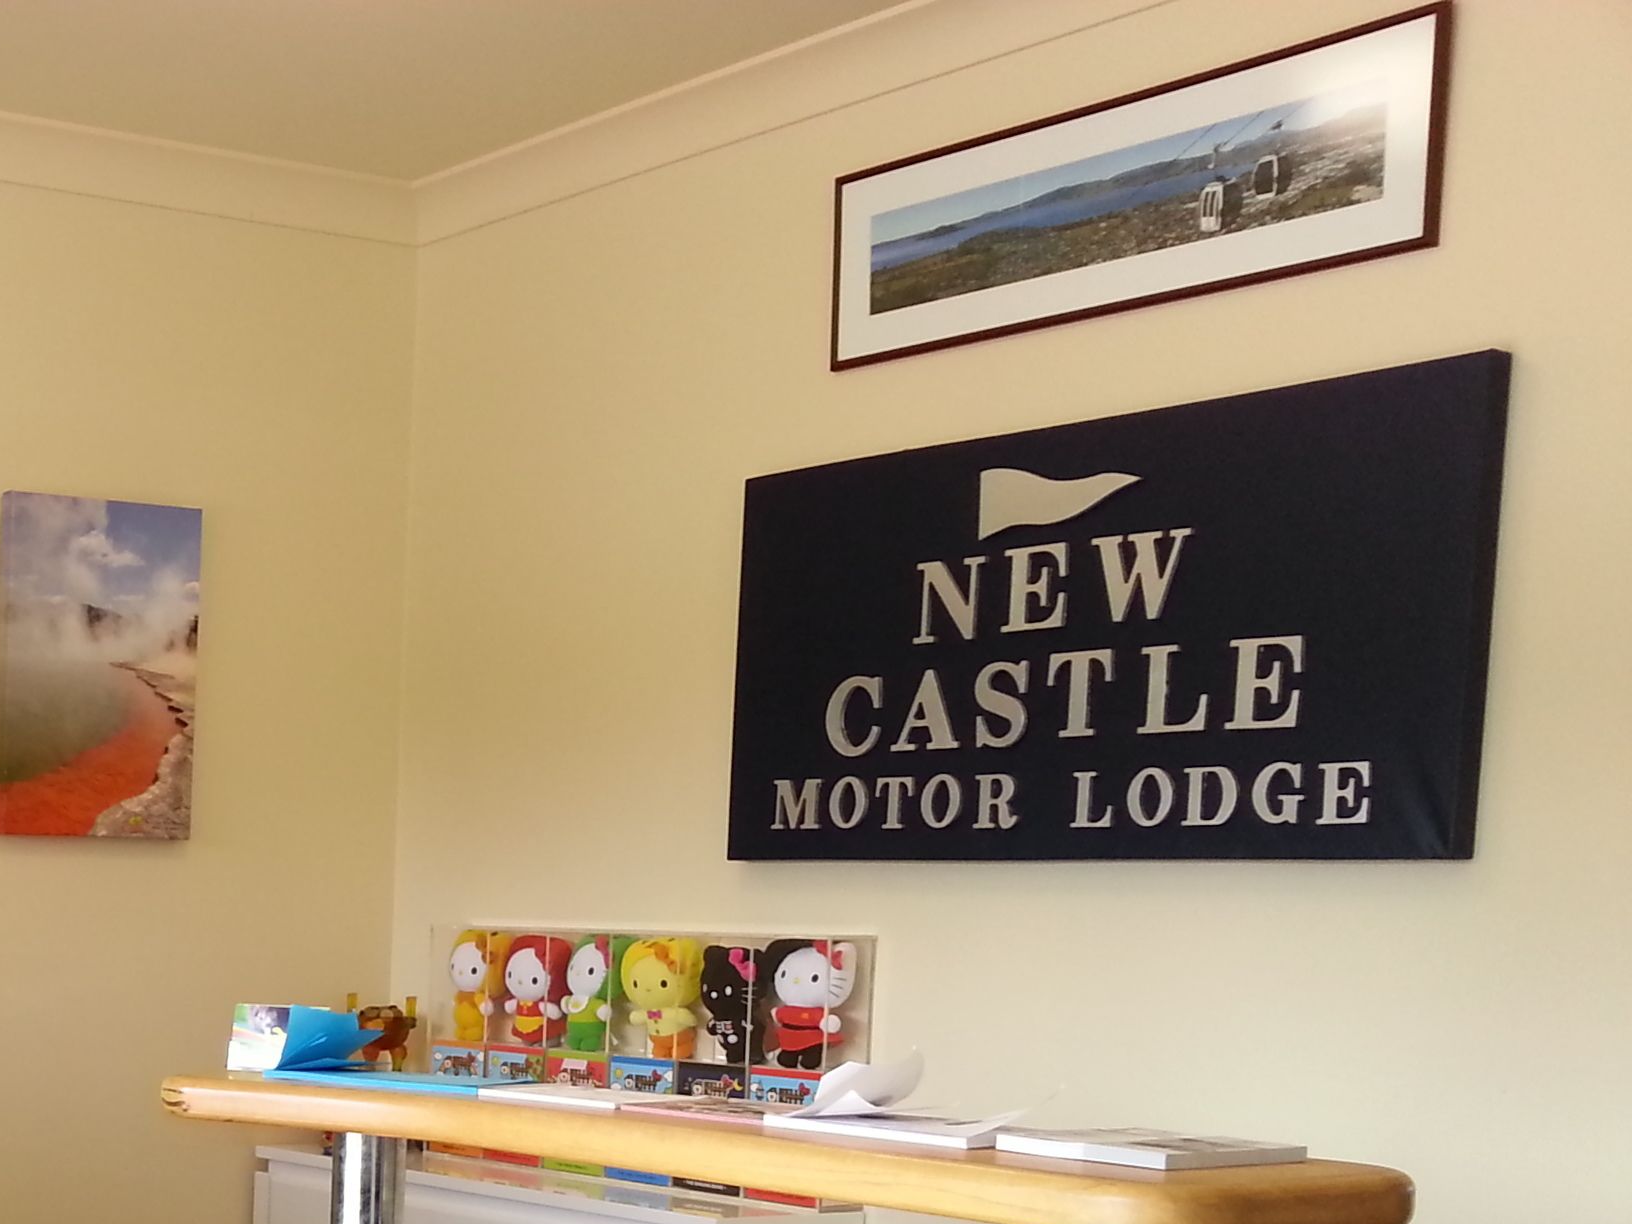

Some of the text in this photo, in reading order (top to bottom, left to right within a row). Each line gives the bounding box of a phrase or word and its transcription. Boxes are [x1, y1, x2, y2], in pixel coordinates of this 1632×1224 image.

[912, 526, 1195, 645] NEW
[824, 634, 1305, 758] CASTLE
[770, 760, 1371, 831] MOTOR LODGE
